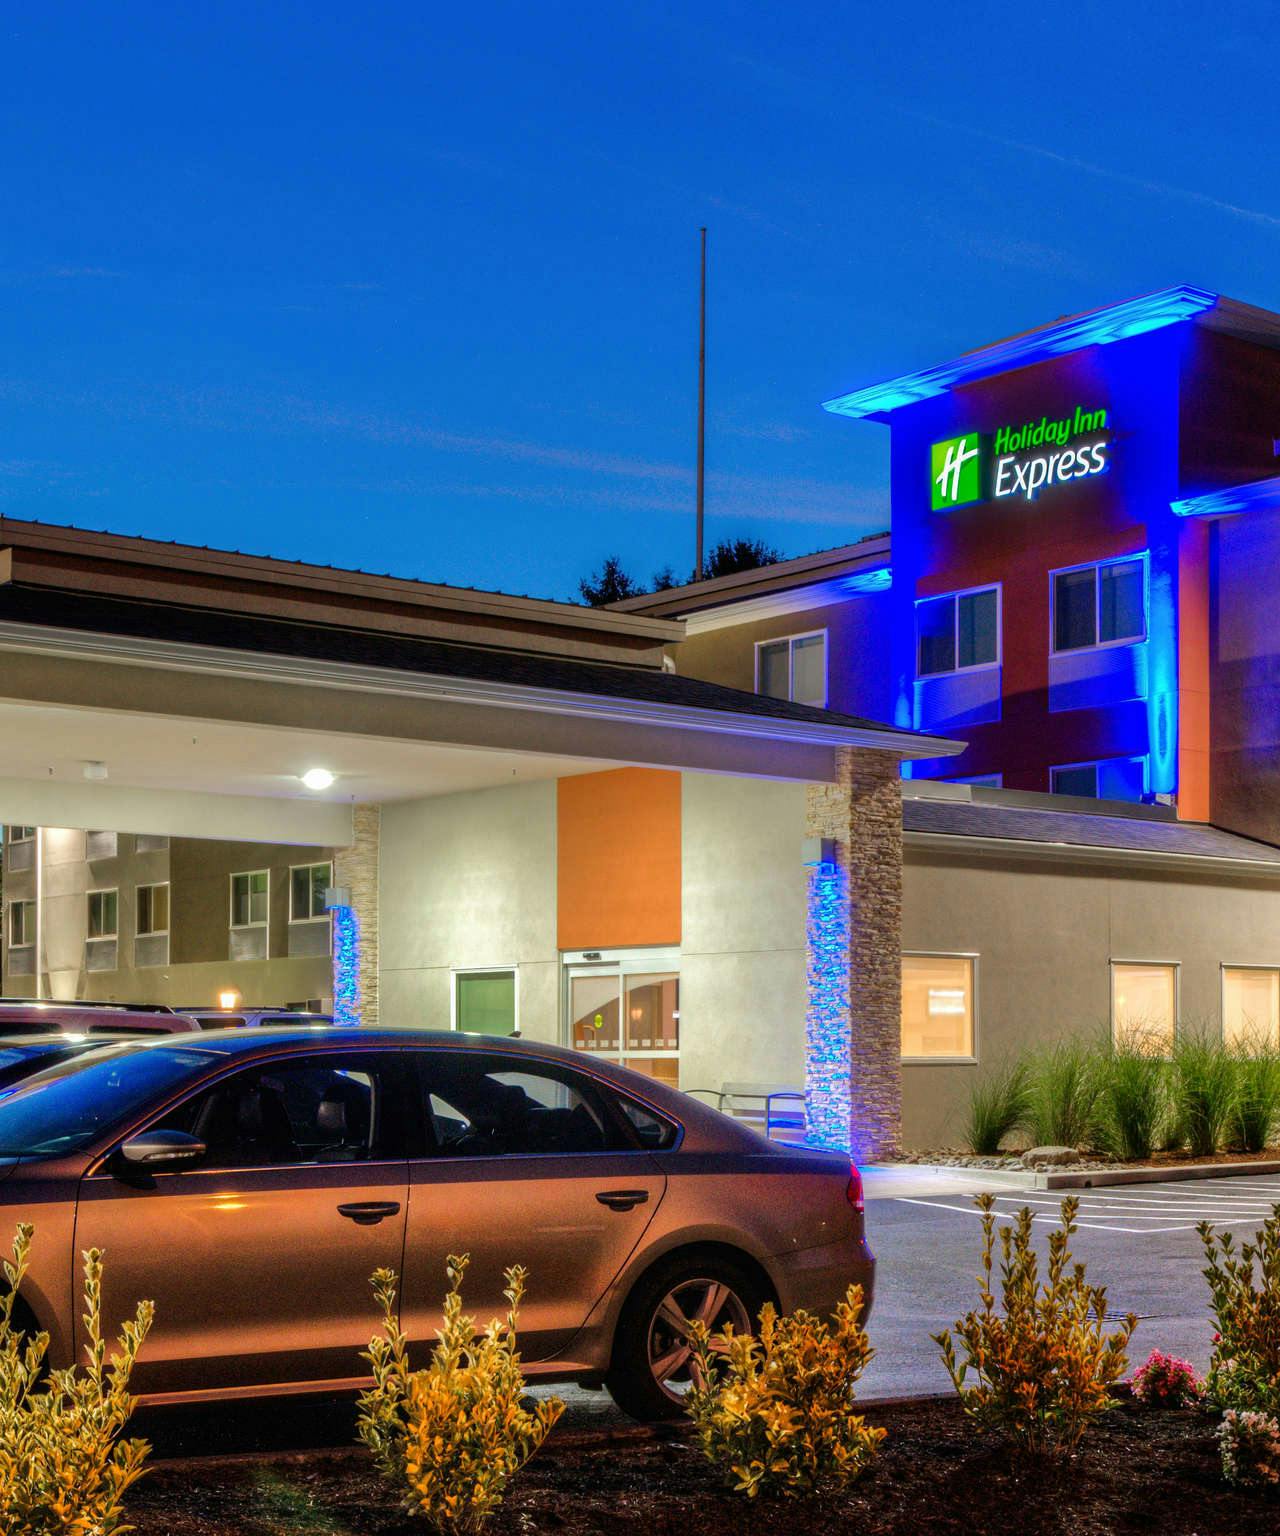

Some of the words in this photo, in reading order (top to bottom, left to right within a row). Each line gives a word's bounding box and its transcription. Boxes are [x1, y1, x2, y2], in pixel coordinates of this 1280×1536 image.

[994, 416, 1072, 456] Holiday
[1072, 406, 1107, 435] Inn
[994, 442, 1107, 500] Express
